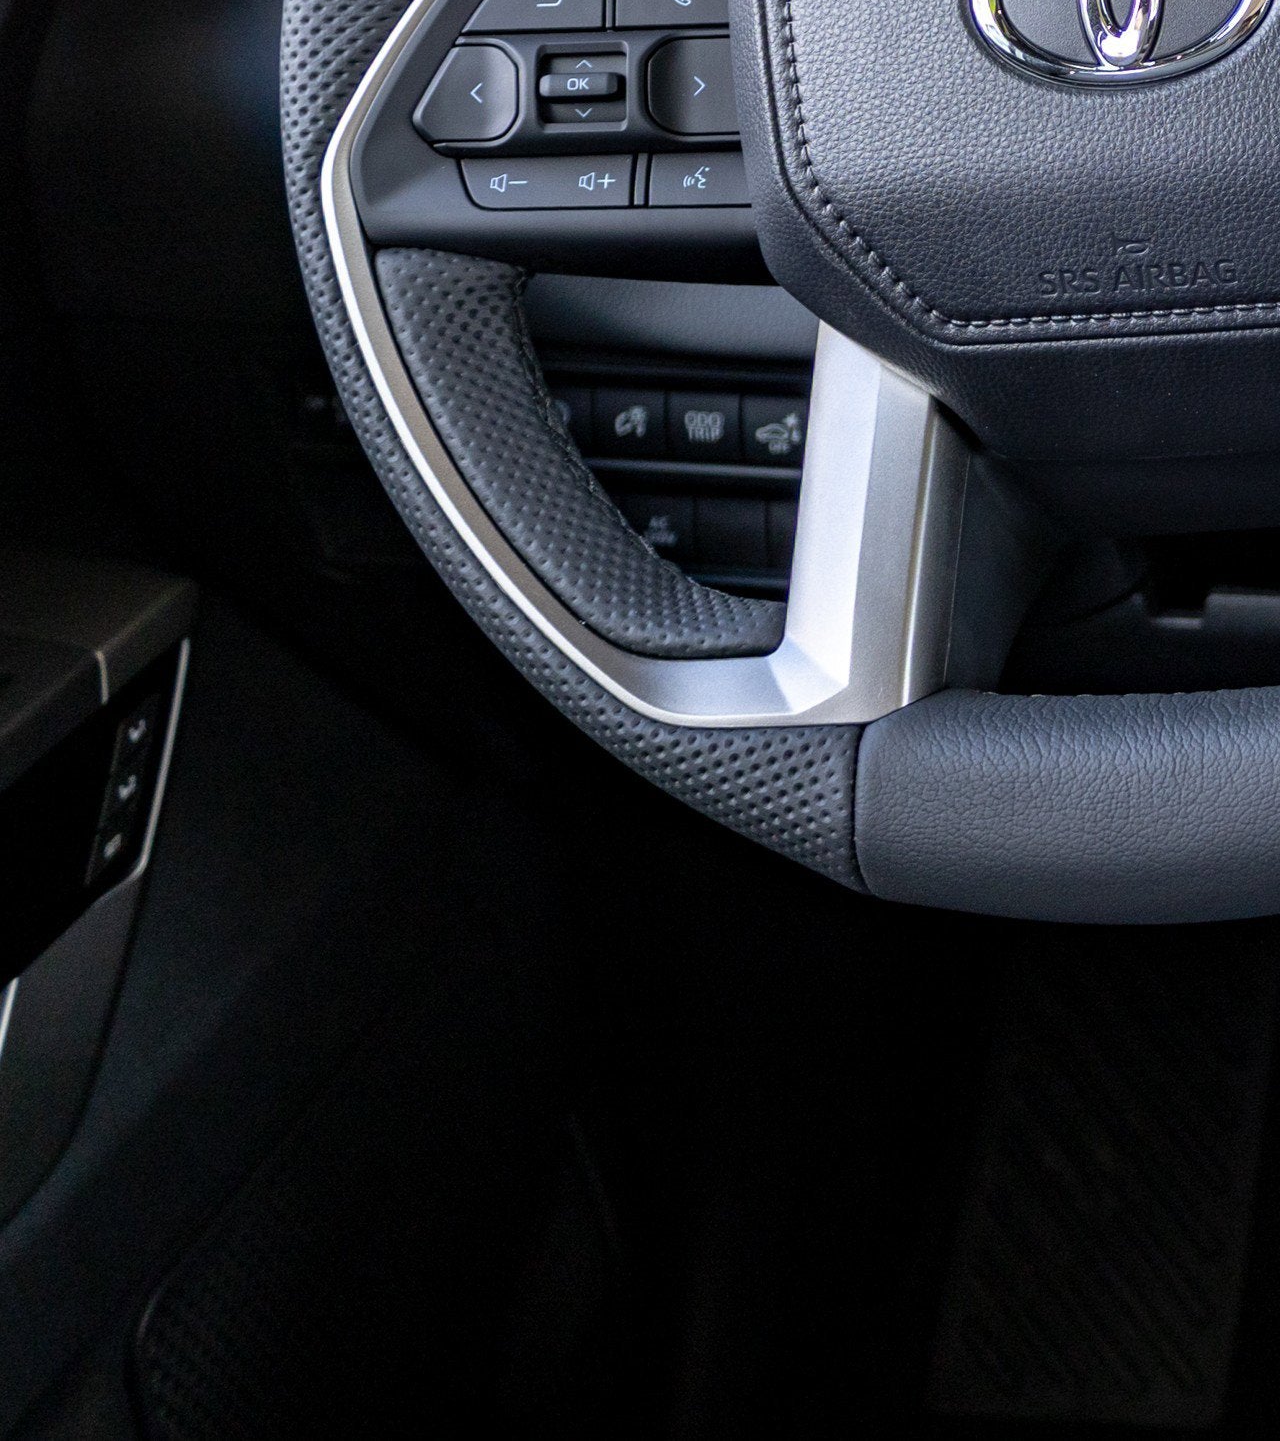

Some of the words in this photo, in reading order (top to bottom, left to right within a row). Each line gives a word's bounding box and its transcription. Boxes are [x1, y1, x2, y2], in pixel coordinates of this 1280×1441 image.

[566, 77, 589, 91] OK
[1038, 267, 1102, 298] SRS
[1112, 259, 1239, 293] AIRBAG
[685, 411, 726, 426] ODO
[688, 425, 723, 442] TRIP
